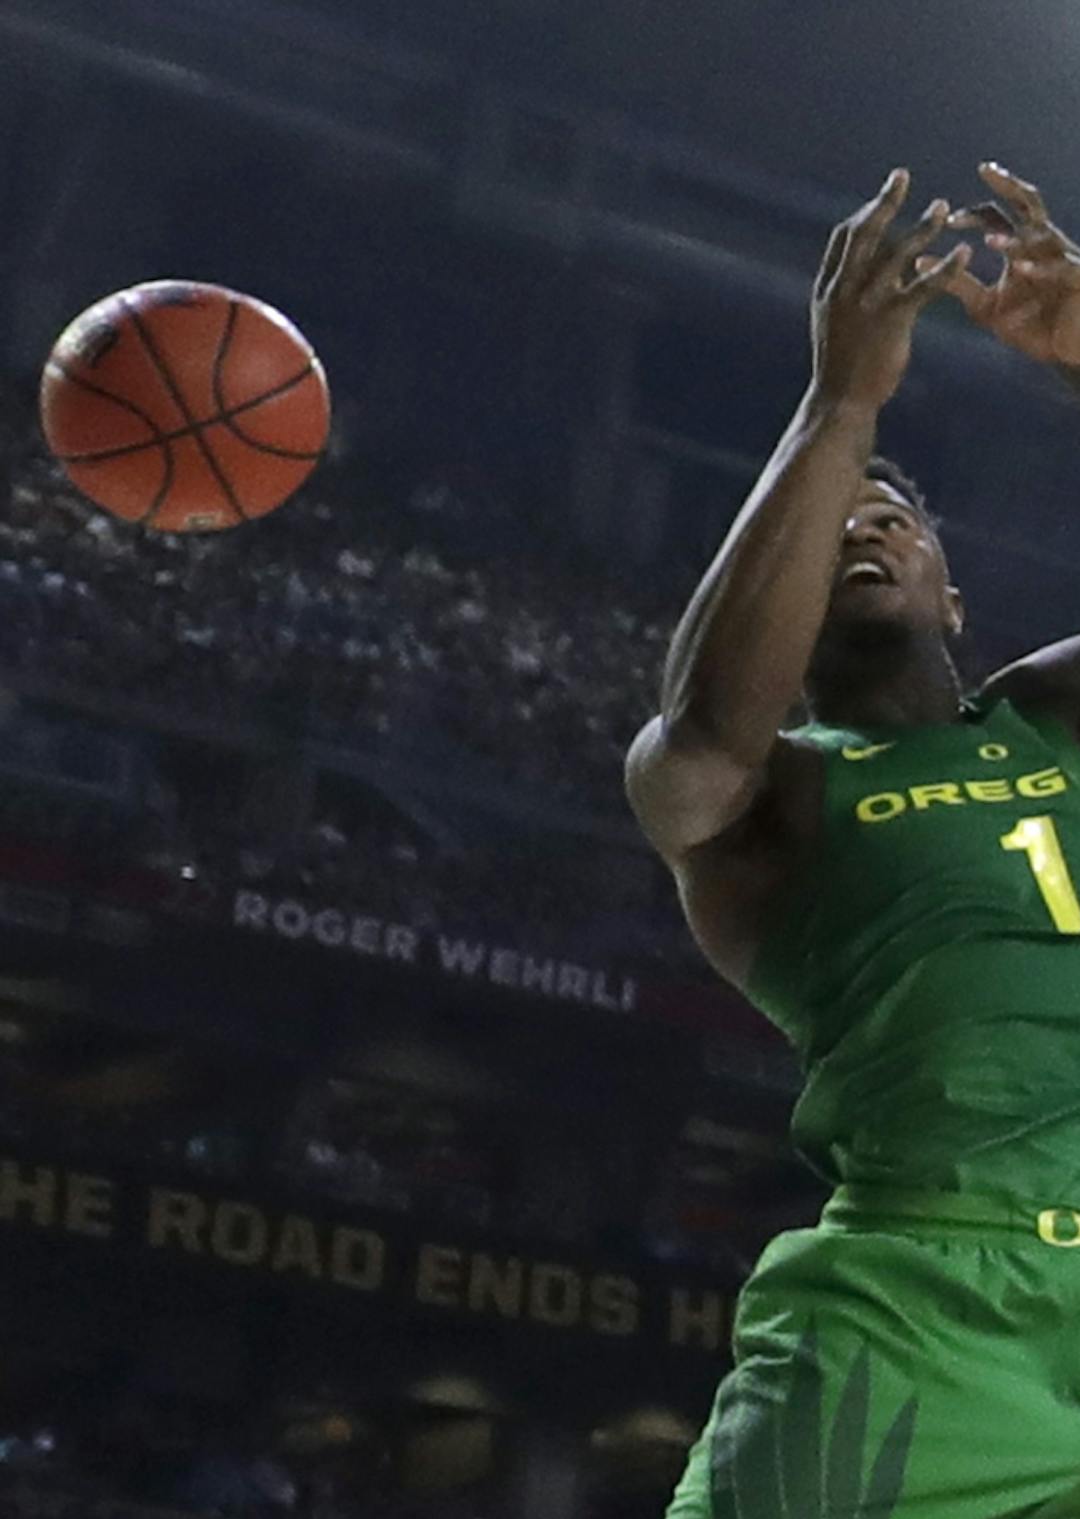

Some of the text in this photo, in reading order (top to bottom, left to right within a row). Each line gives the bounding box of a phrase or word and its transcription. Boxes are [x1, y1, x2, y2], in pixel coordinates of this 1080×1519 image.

[855, 767, 1068, 823] OREG
[233, 888, 637, 1013] ROGER WEHRLI
[146, 1186, 386, 1291] ROAD
[415, 1242, 641, 1336] ENDS
